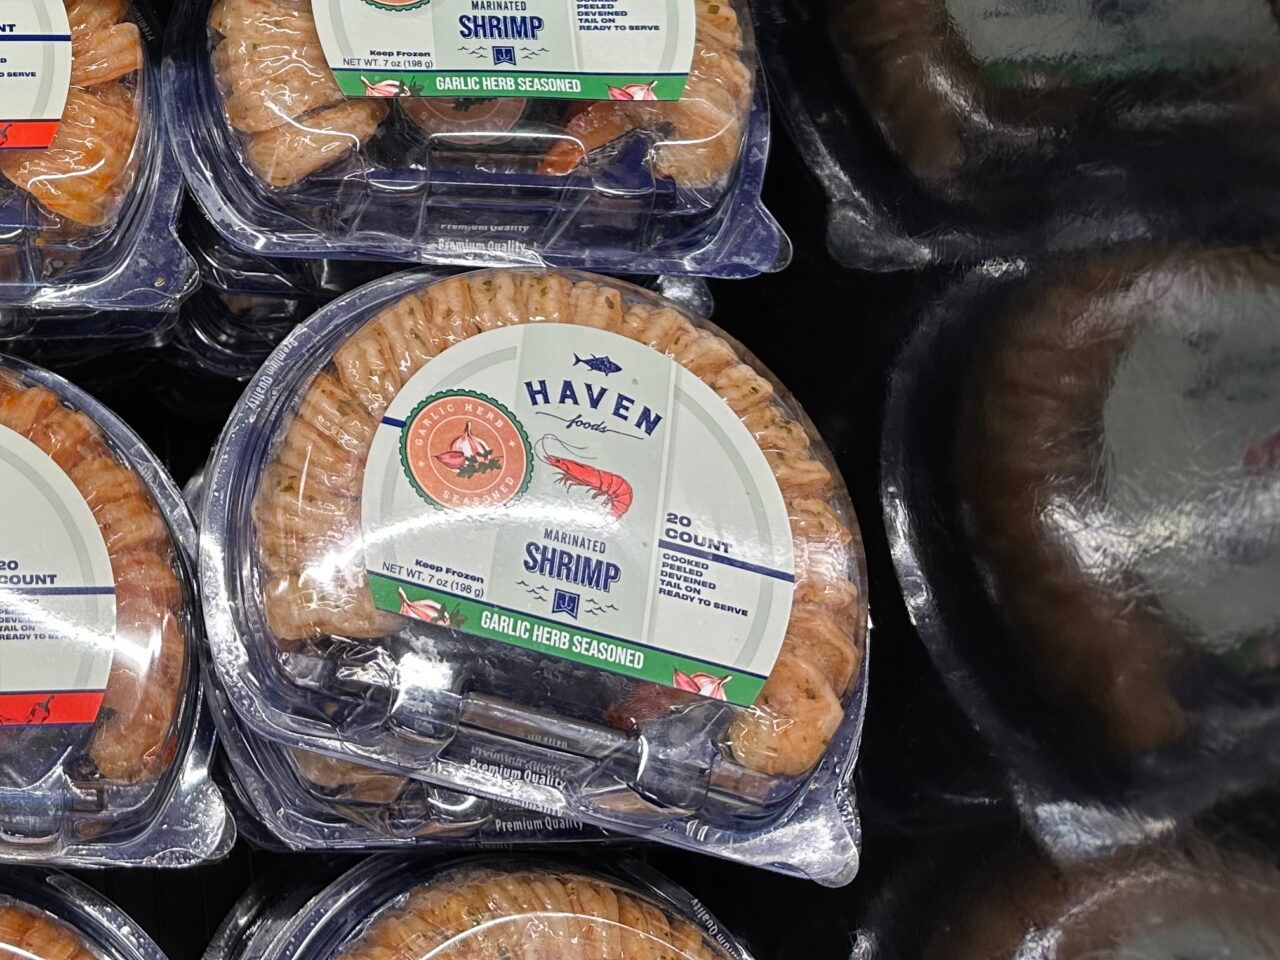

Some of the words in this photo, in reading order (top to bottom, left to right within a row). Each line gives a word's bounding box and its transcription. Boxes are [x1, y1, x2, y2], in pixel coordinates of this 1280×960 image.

[471, 0, 527, 11] MARINATED
[458, 14, 545, 40] SHRIMP
[436, 77, 480, 90] GARLIC
[483, 77, 515, 91] HERB
[518, 78, 580, 92] SEASONED
[524, 379, 663, 436] HAVEN
[415, 403, 455, 446] GARLIC
[464, 403, 504, 428] HERB
[666, 512, 692, 527] 20
[543, 527, 606, 554] MARINATED
[664, 527, 733, 554] COUNT
[414, 558, 443, 573] Keep
[445, 566, 484, 584] Frozen
[523, 541, 621, 594] SHRIMP
[661, 561, 704, 578] PEELED
[663, 553, 709, 570] COOKED
[381, 561, 404, 575] NET
[406, 567, 425, 581] WT.
[428, 573, 435, 584] 7
[436, 577, 448, 587] oz
[450, 580, 472, 594] (198
[474, 586, 484, 599] g)
[659, 578, 683, 591] TAIL
[684, 585, 701, 595] ON
[660, 570, 717, 590] DEVEINED
[658, 587, 695, 603] READY
[697, 597, 712, 607] TO
[713, 601, 749, 617] SERVE
[481, 610, 530, 639] GARLIC
[532, 625, 570, 650] HERB
[572, 637, 645, 670] SEASONED
[469, 758, 521, 780] Premium
[523, 768, 567, 791] Quality
[495, 818, 543, 833] Premium
